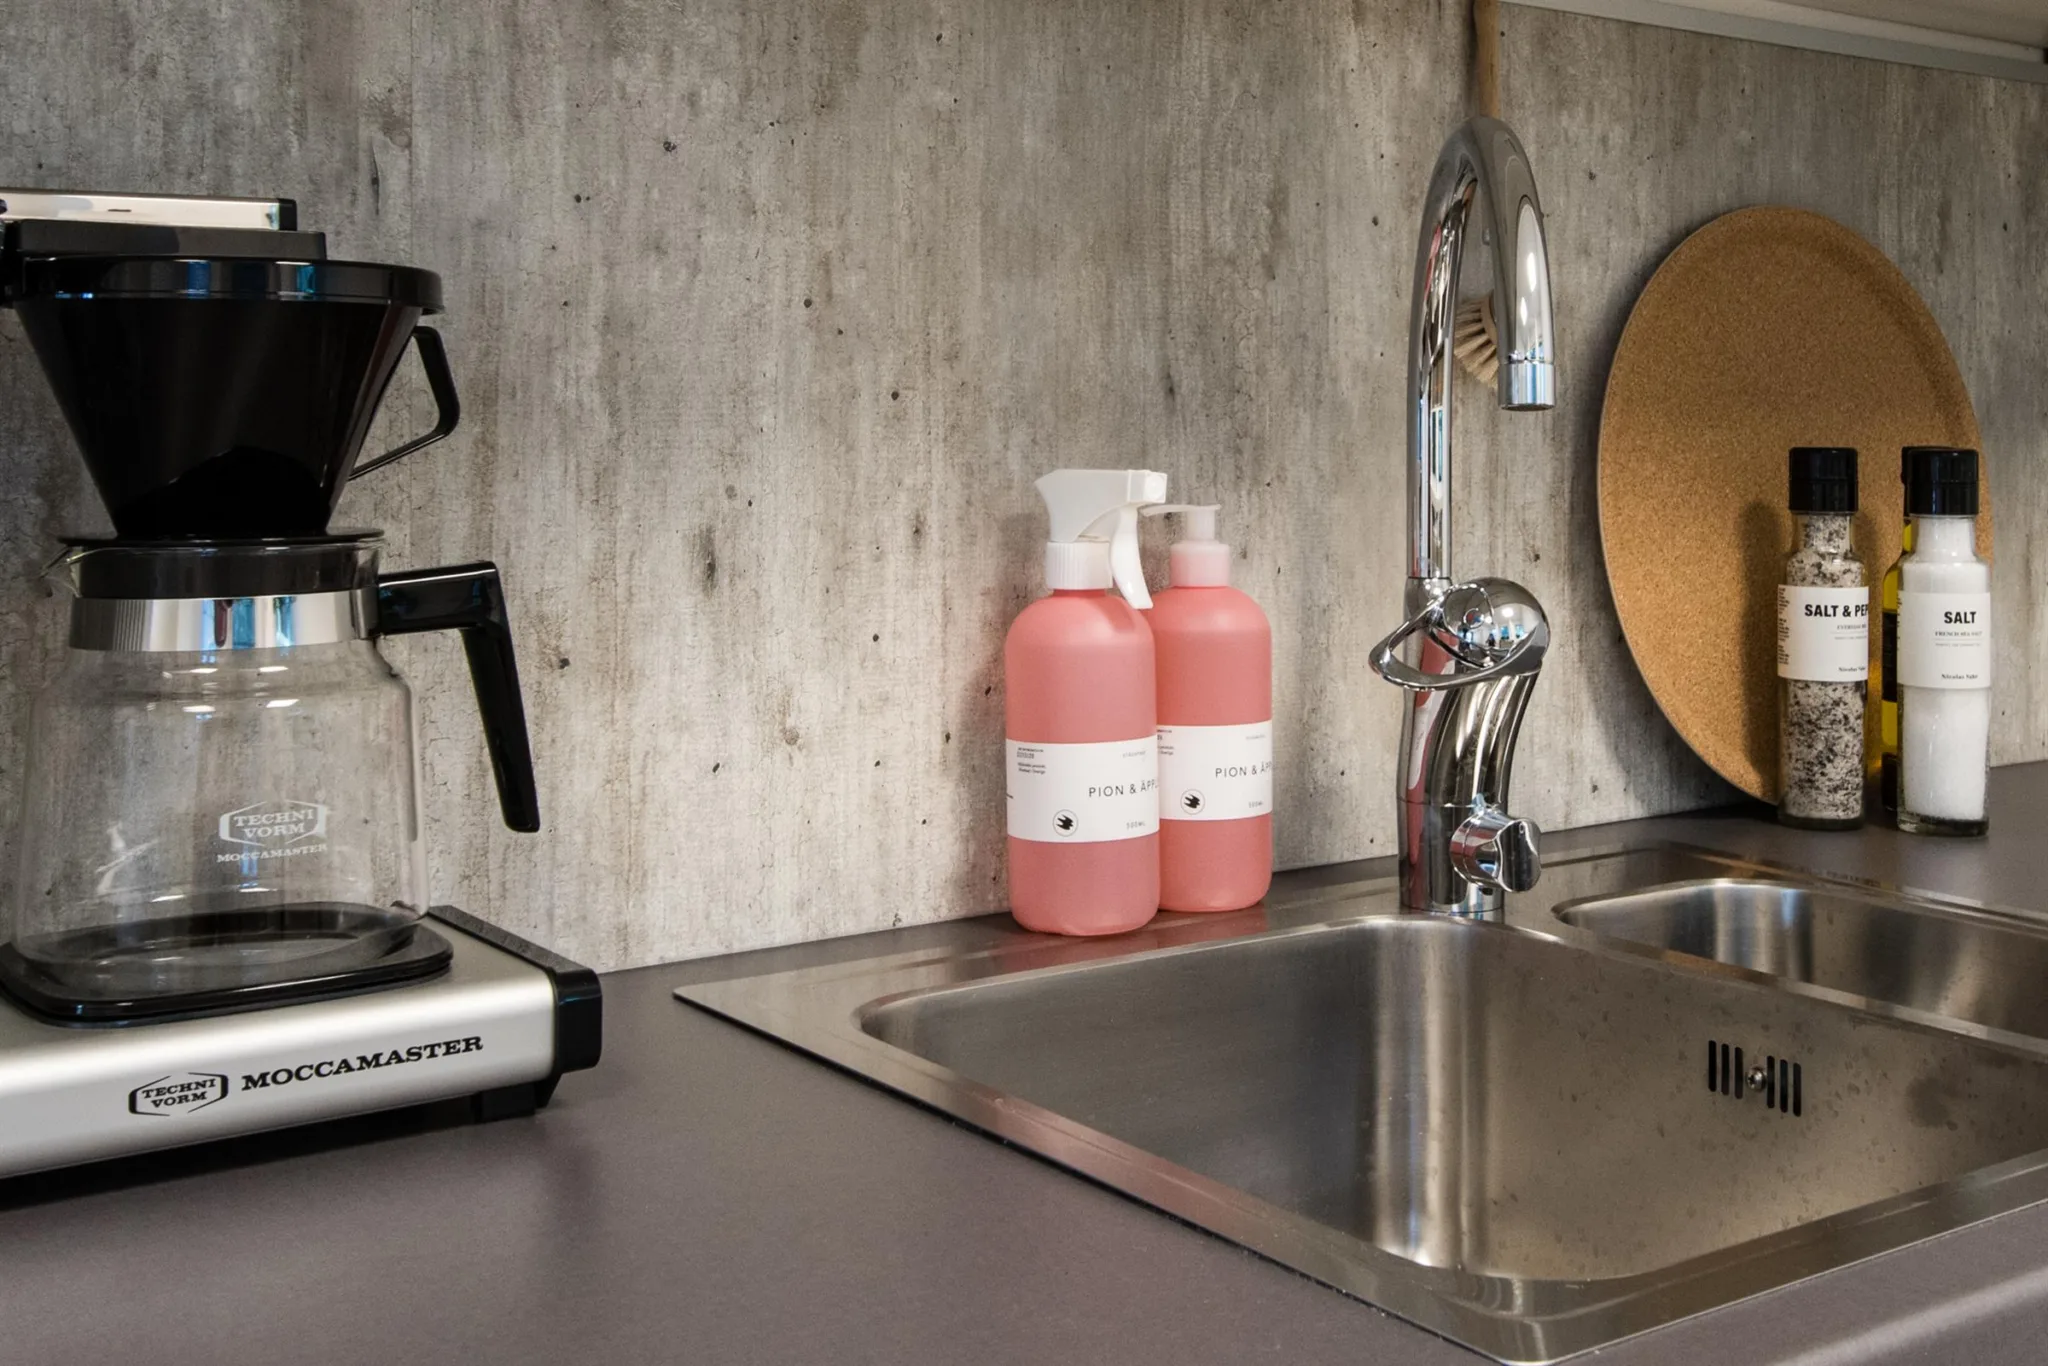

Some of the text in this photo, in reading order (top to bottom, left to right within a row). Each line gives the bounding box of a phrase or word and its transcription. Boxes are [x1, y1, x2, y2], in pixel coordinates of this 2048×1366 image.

[1804, 603, 1839, 617] SALT
[1842, 605, 1852, 617] &
[1943, 611, 1977, 624] SALT
[1215, 766, 1247, 778] PION
[1251, 764, 1257, 775] &
[1088, 785, 1124, 798] PION
[1129, 783, 1137, 794] &
[233, 808, 315, 827] TECHNI
[243, 822, 305, 838] VORM
[216, 843, 328, 863] MOCCAMASTER
[241, 1036, 484, 1091] MOCCAMASTER
[142, 1078, 217, 1099] TECHNI
[151, 1091, 208, 1109] VORM
